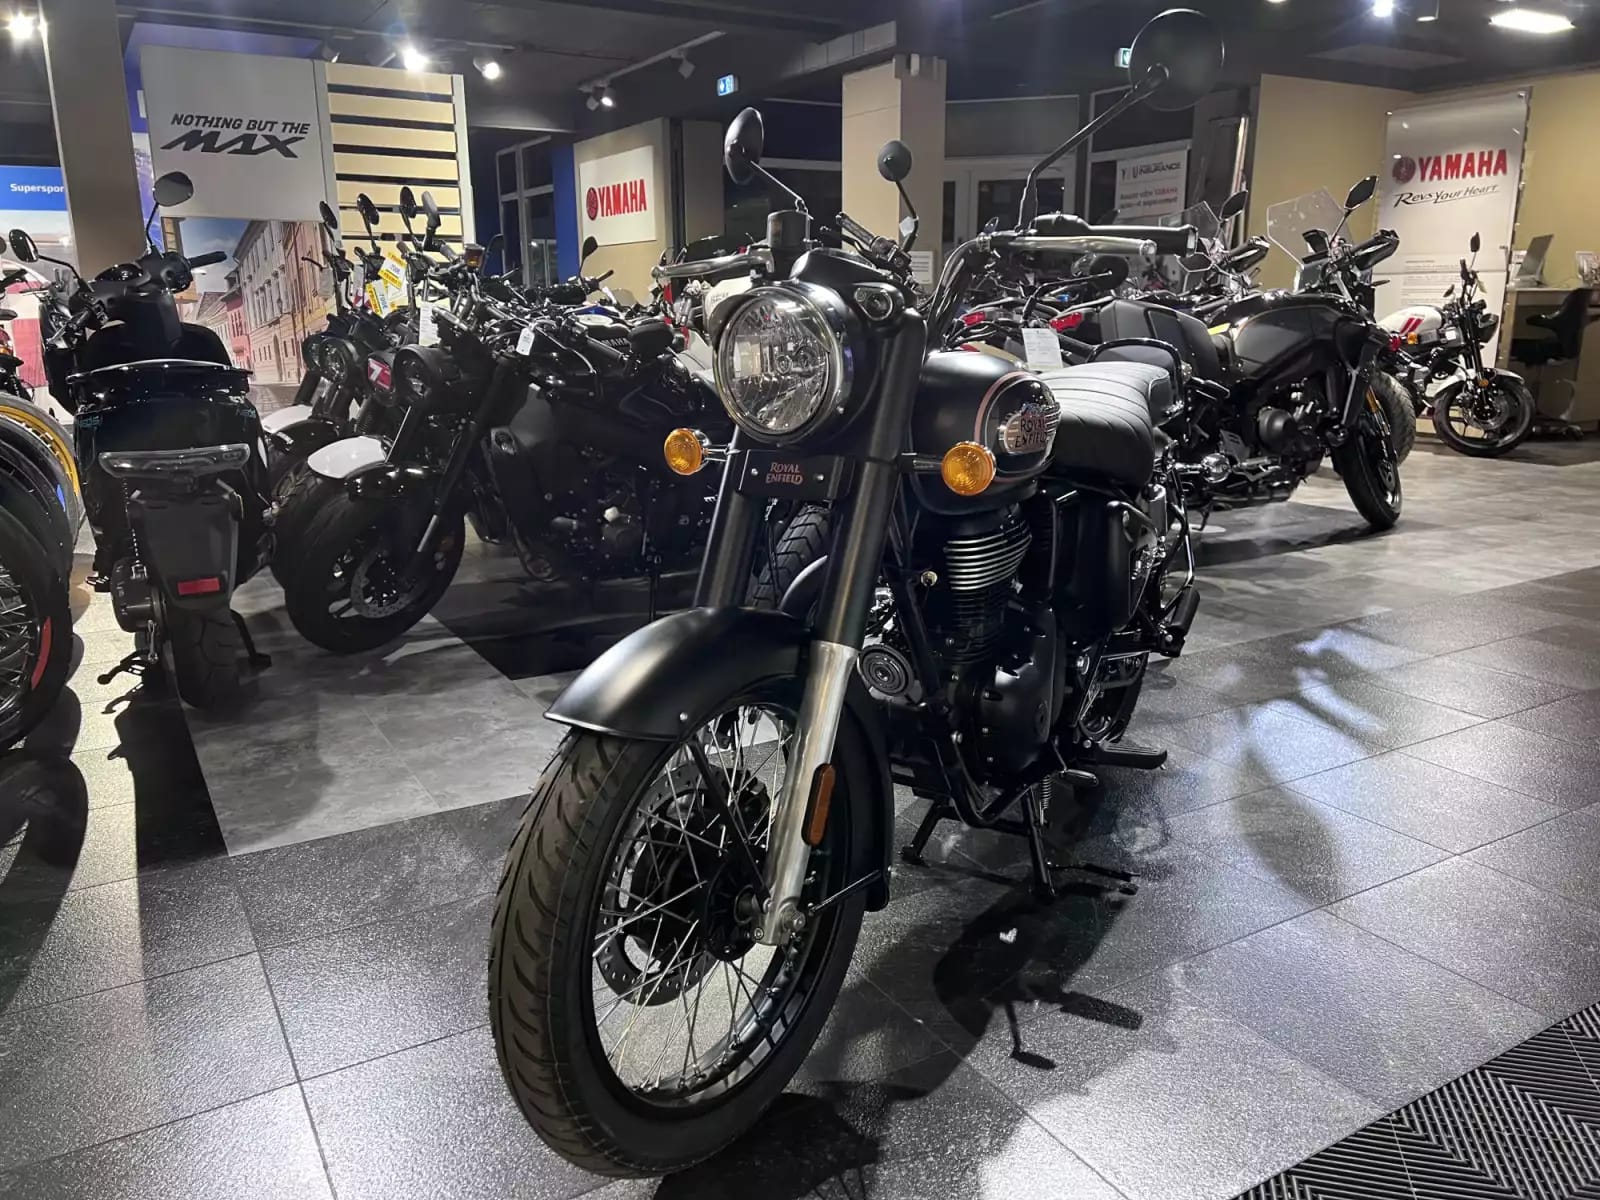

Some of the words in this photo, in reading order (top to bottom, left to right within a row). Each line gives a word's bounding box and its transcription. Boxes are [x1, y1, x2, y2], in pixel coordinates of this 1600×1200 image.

[171, 113, 243, 130] NOTHING
[246, 119, 278, 132] BUT
[281, 122, 311, 134] THE
[160, 129, 306, 159] MAX
[1418, 149, 1507, 182] YAMAHA
[9, 183, 65, 195] Superspor
[598, 179, 647, 217] YAMAHA
[1393, 192, 1432, 208] Revs
[1432, 190, 1462, 204] Your
[1463, 184, 1499, 197] Heart
[1020, 417, 1046, 433] ROYAL
[1014, 431, 1048, 448] ENFIELD
[770, 462, 800, 473] ROYAL
[766, 473, 804, 485] ENFIELD
